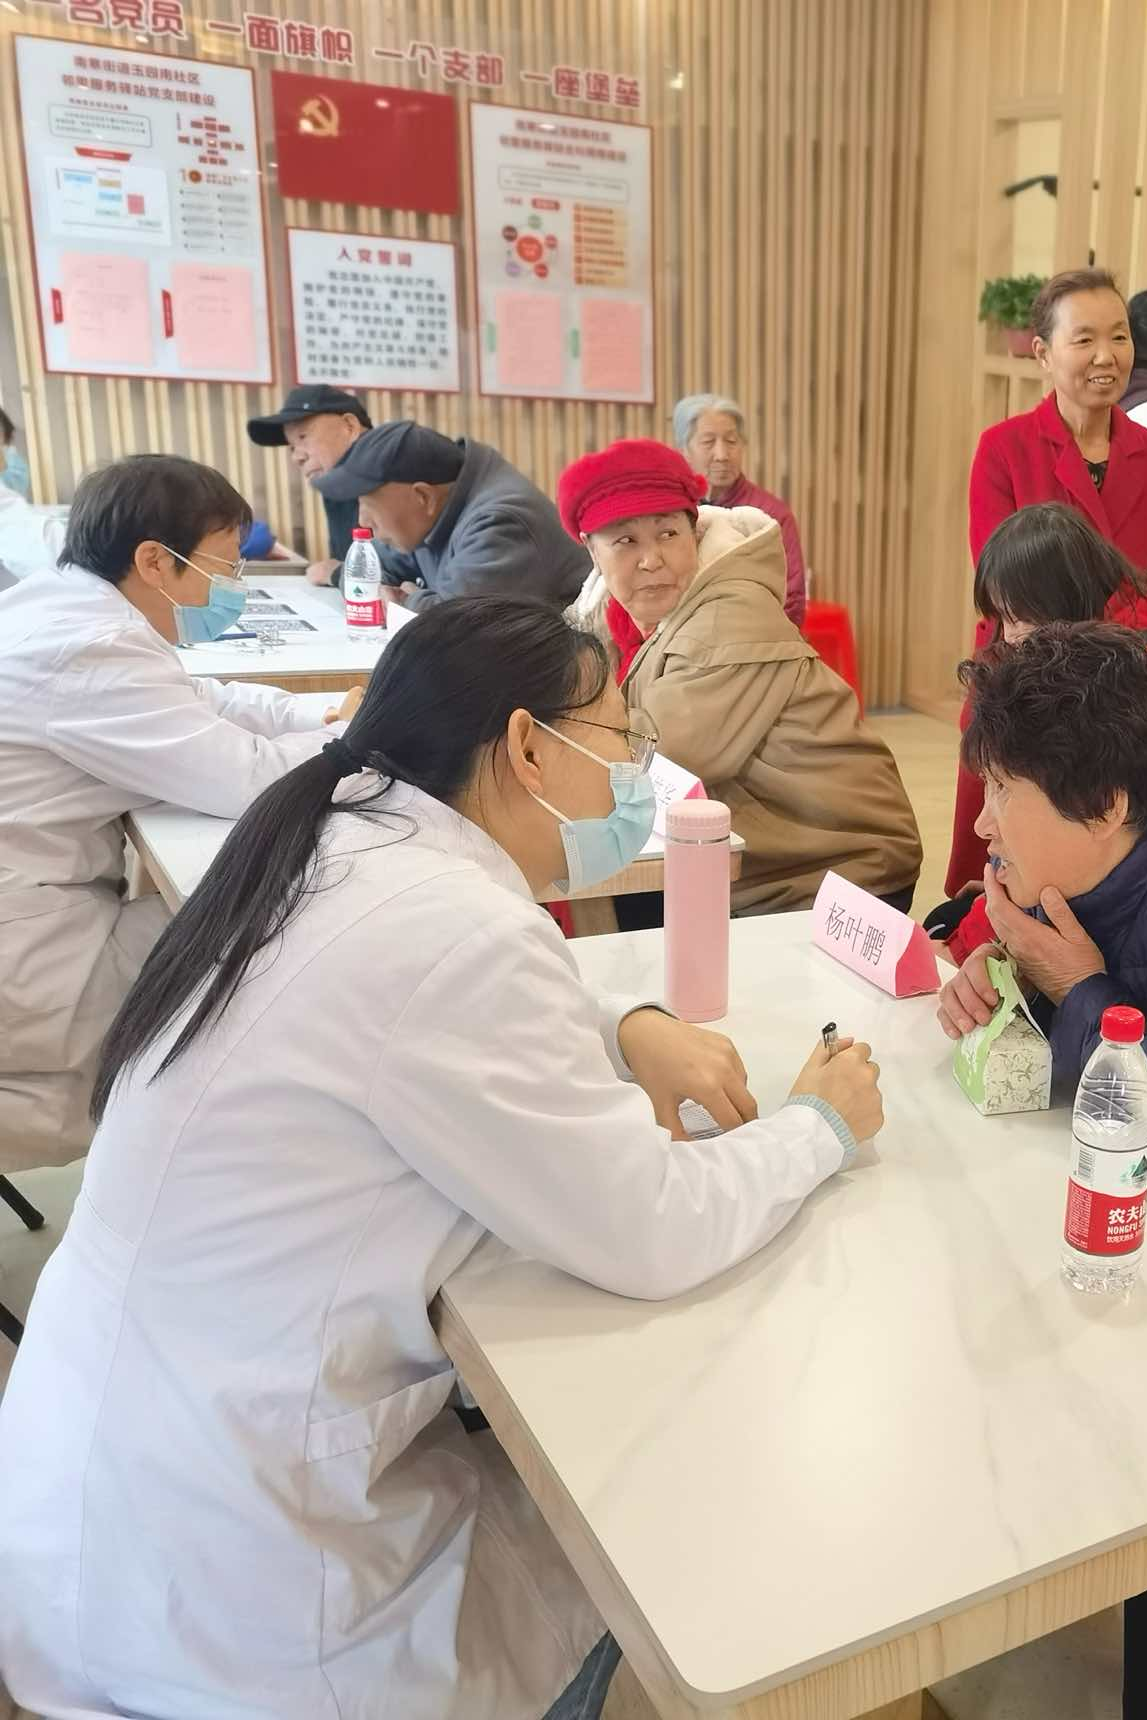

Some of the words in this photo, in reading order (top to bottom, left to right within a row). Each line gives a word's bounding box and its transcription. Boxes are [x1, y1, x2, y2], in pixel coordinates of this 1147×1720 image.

[208, 14, 353, 62] 一面旗帜
[373, 43, 503, 86] 一个支部
[522, 67, 640, 108] 一座堡垒
[824, 901, 888, 966] 杨叶鹏
[1107, 1224, 1138, 1235] NONGFU
